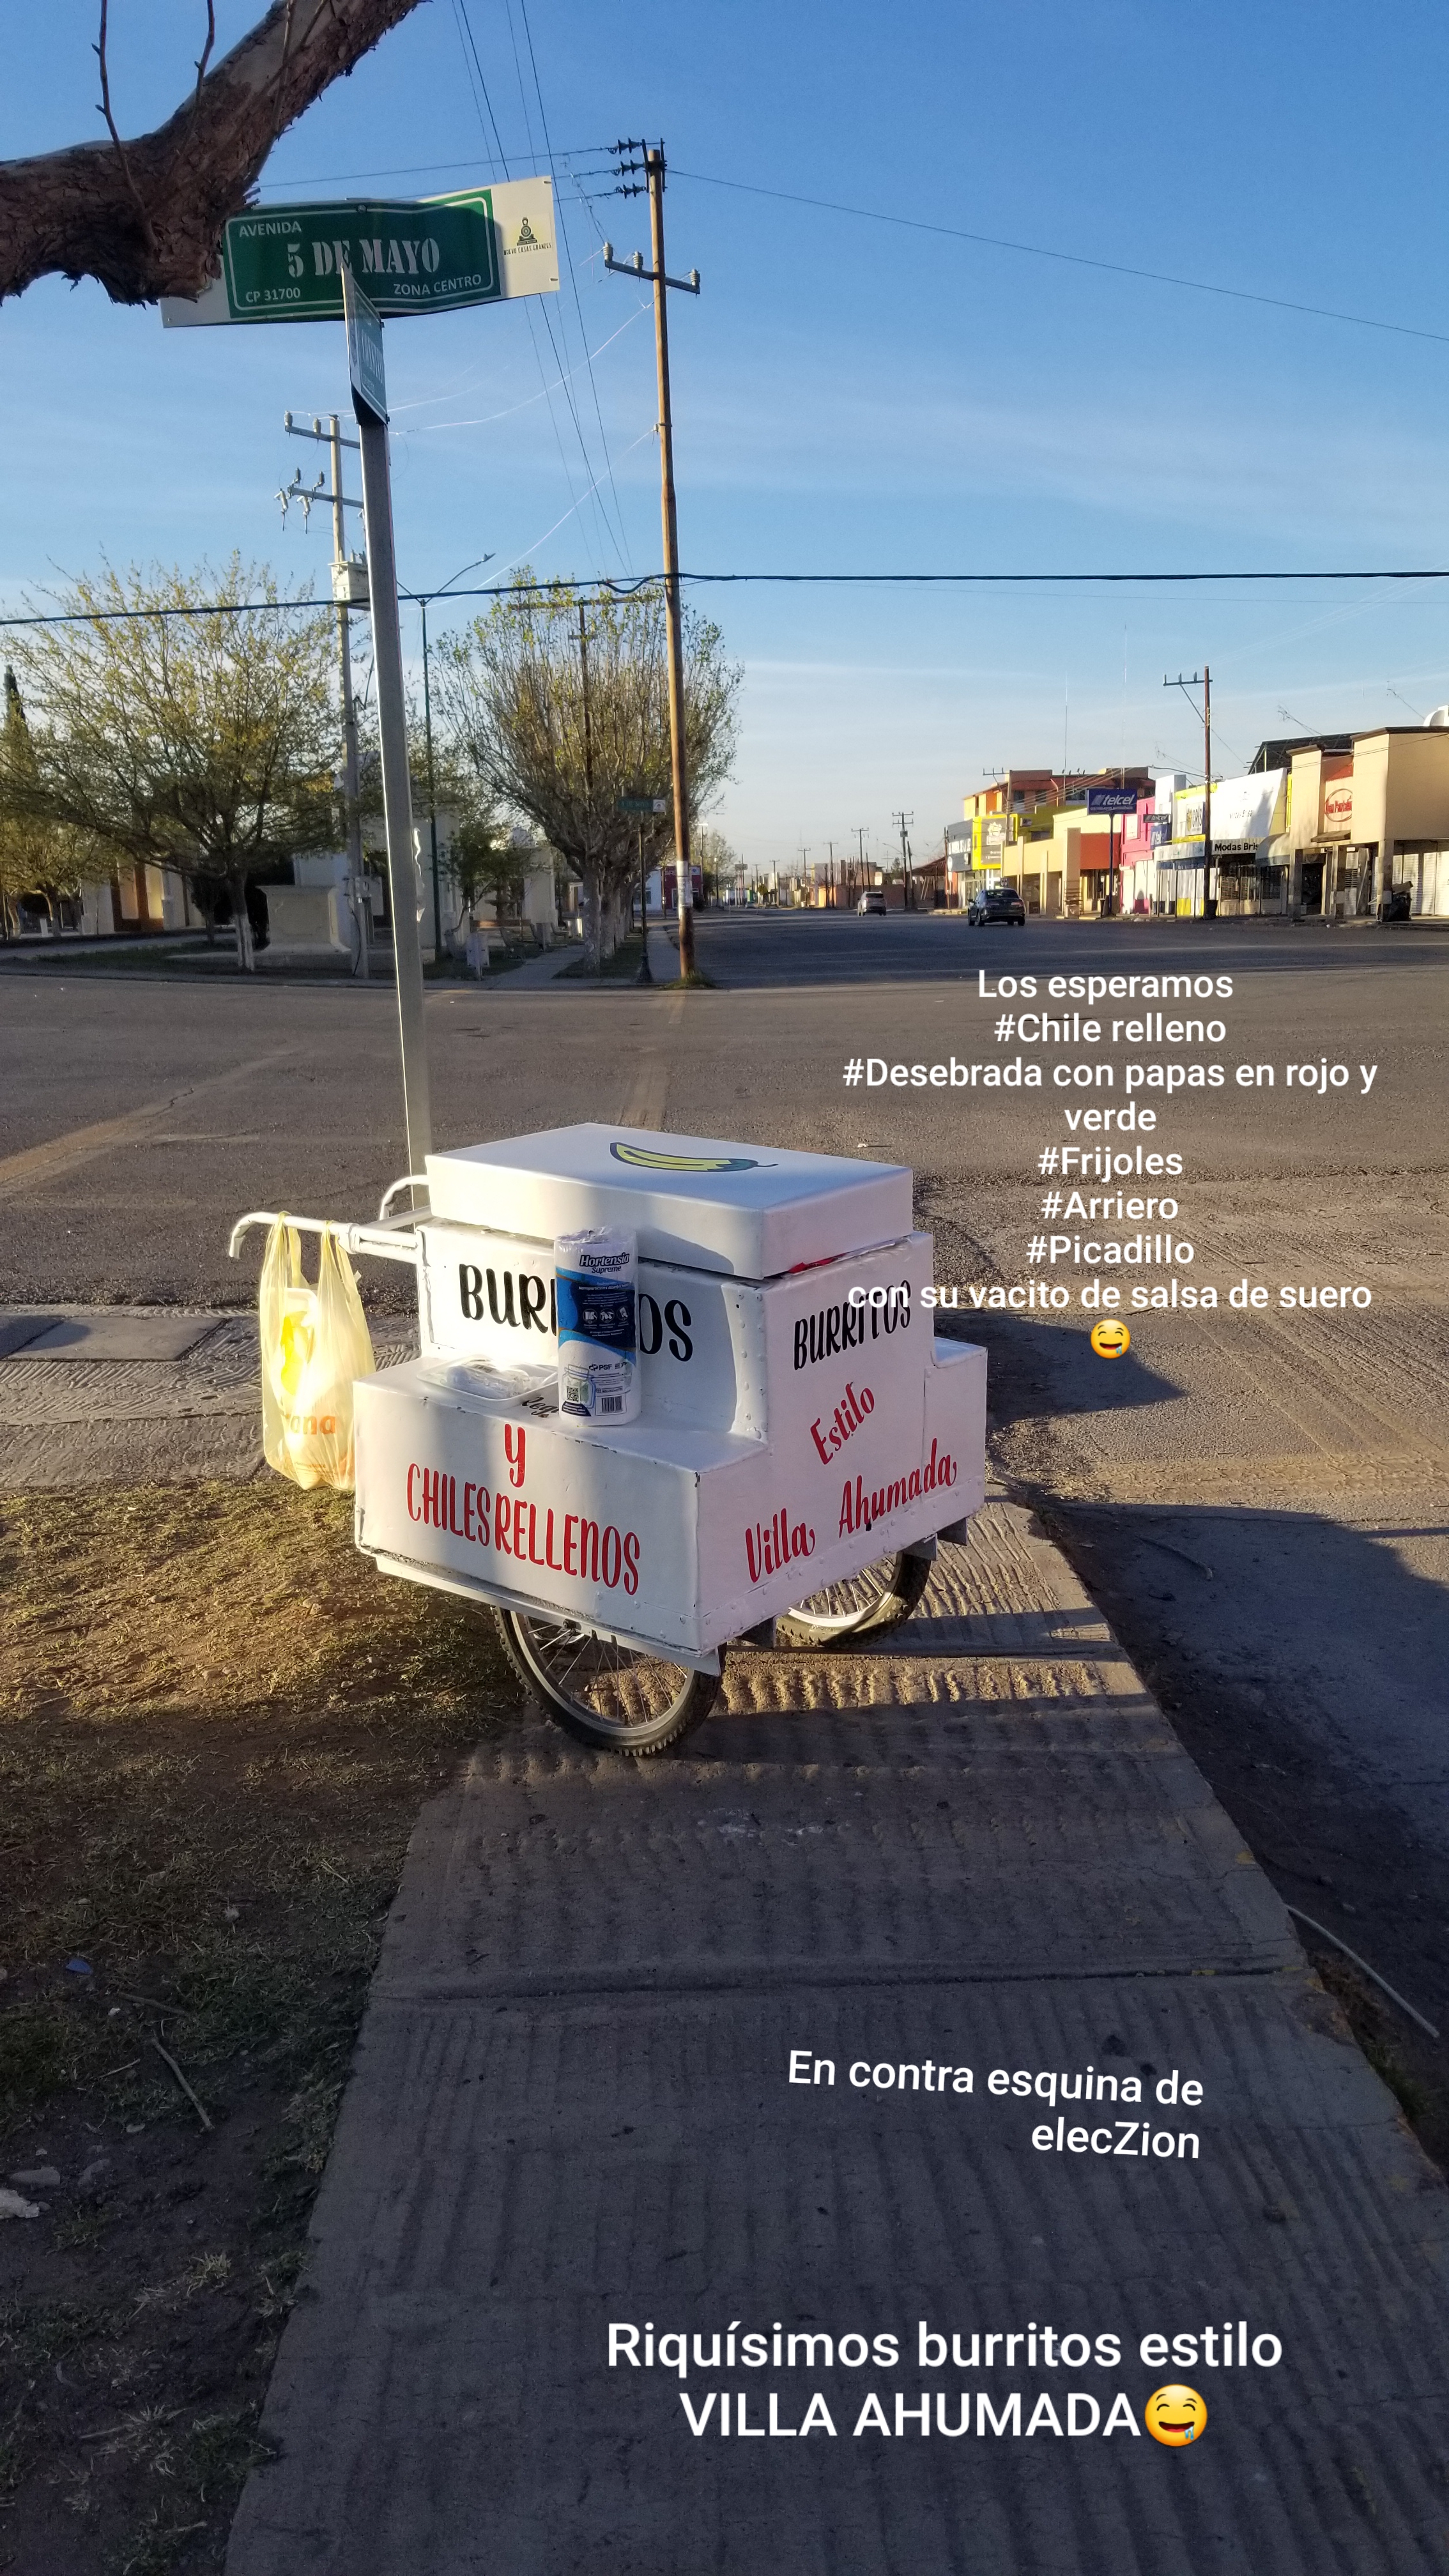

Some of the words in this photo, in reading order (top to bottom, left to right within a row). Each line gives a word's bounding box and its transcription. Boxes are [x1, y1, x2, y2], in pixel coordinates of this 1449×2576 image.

[239, 221, 302, 238] AVENIDA
[287, 243, 304, 278] 5
[312, 240, 352, 276] DE
[358, 238, 440, 275] MAYO
[518, 245, 532, 254] CASAS
[394, 283, 431, 296] ZONA
[434, 273, 482, 293] CENTRO
[245, 290, 260, 303] CP
[264, 287, 301, 302] 31700
[1102, 794, 1135, 806] telcel
[1215, 843, 1242, 852] Modas
[579, 1252, 630, 1267] Hortensia
[794, 1280, 911, 1370] BURRITOS
[810, 1382, 875, 1466] Estilo
[745, 1508, 816, 1584] Villa
[839, 1438, 958, 1538] Ahumada
